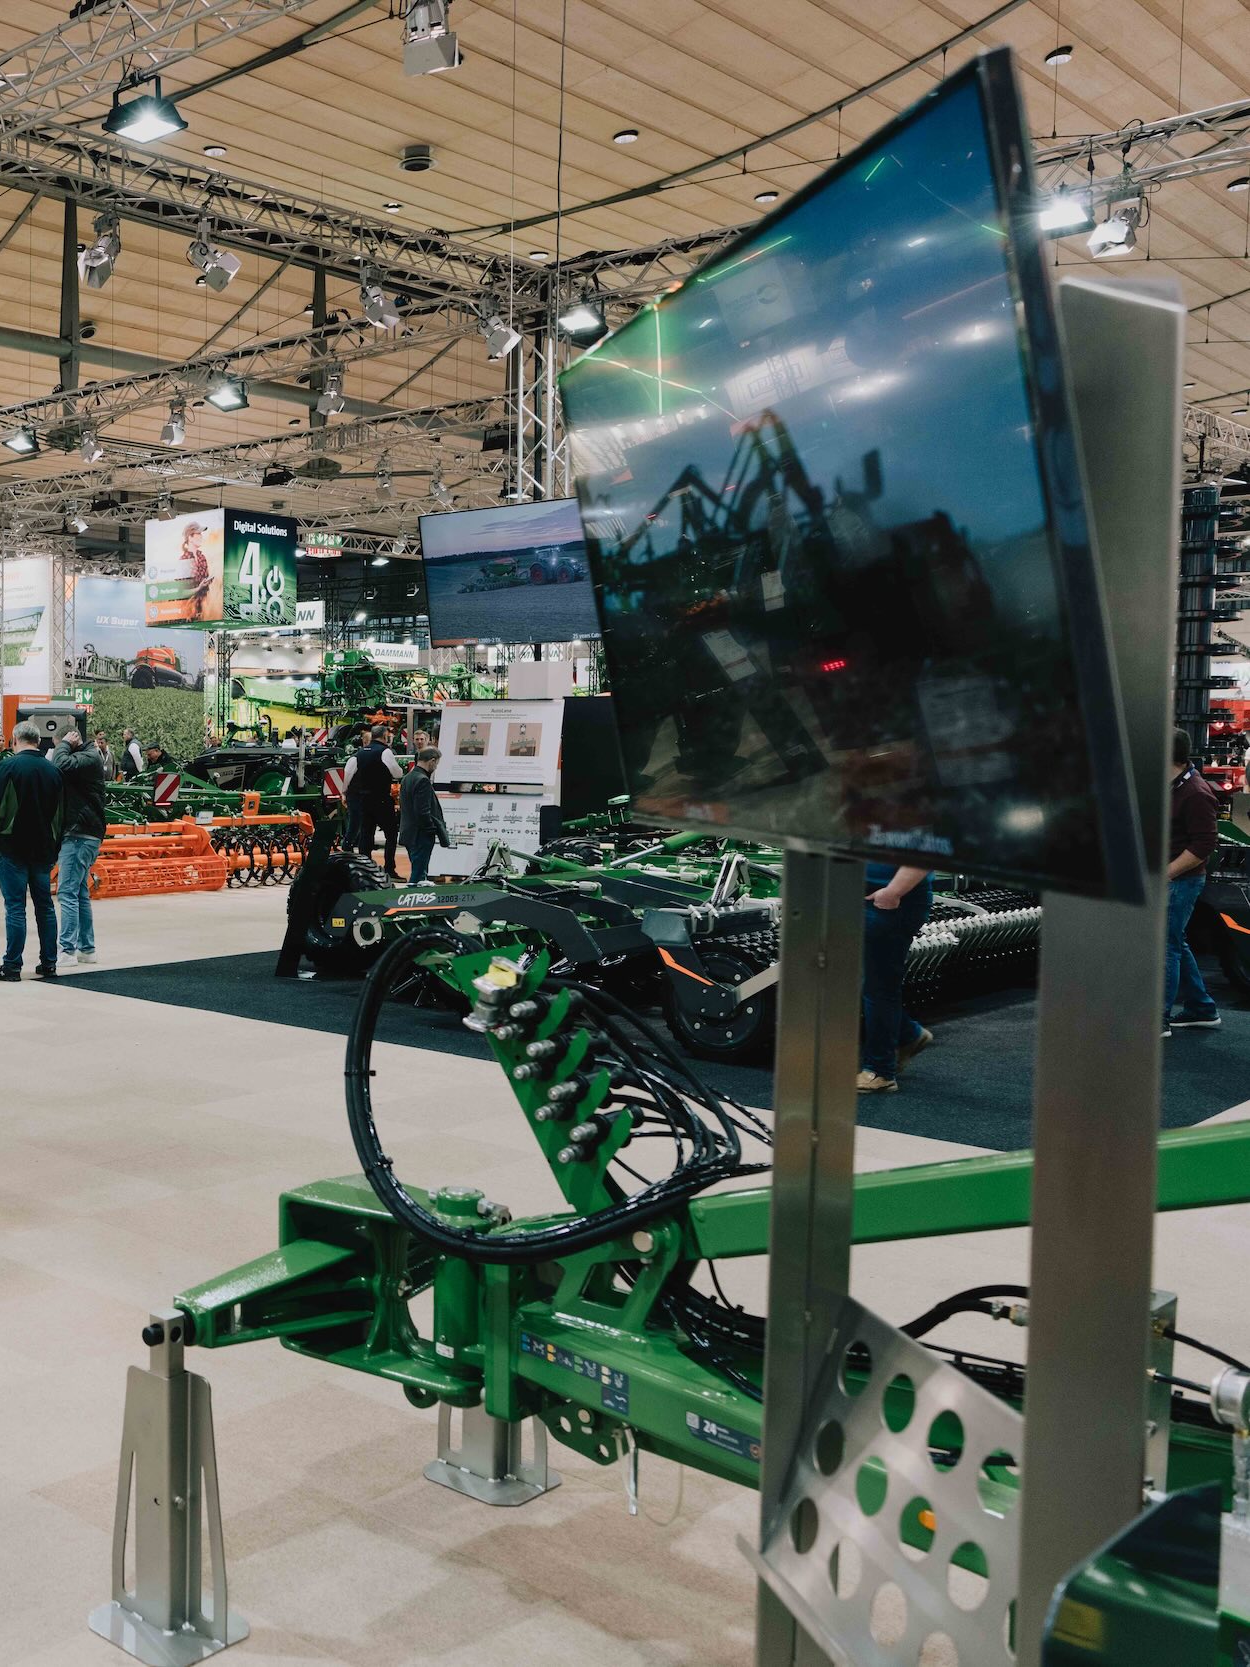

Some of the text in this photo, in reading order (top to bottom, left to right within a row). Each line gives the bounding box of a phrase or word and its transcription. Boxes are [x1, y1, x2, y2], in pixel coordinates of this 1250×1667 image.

[233, 520, 288, 538] Digital Solutions
[96, 615, 139, 628] UX Super
[374, 648, 415, 659] DAMMANN
[397, 891, 438, 908] CATROS
[703, 1419, 718, 1436] 24
